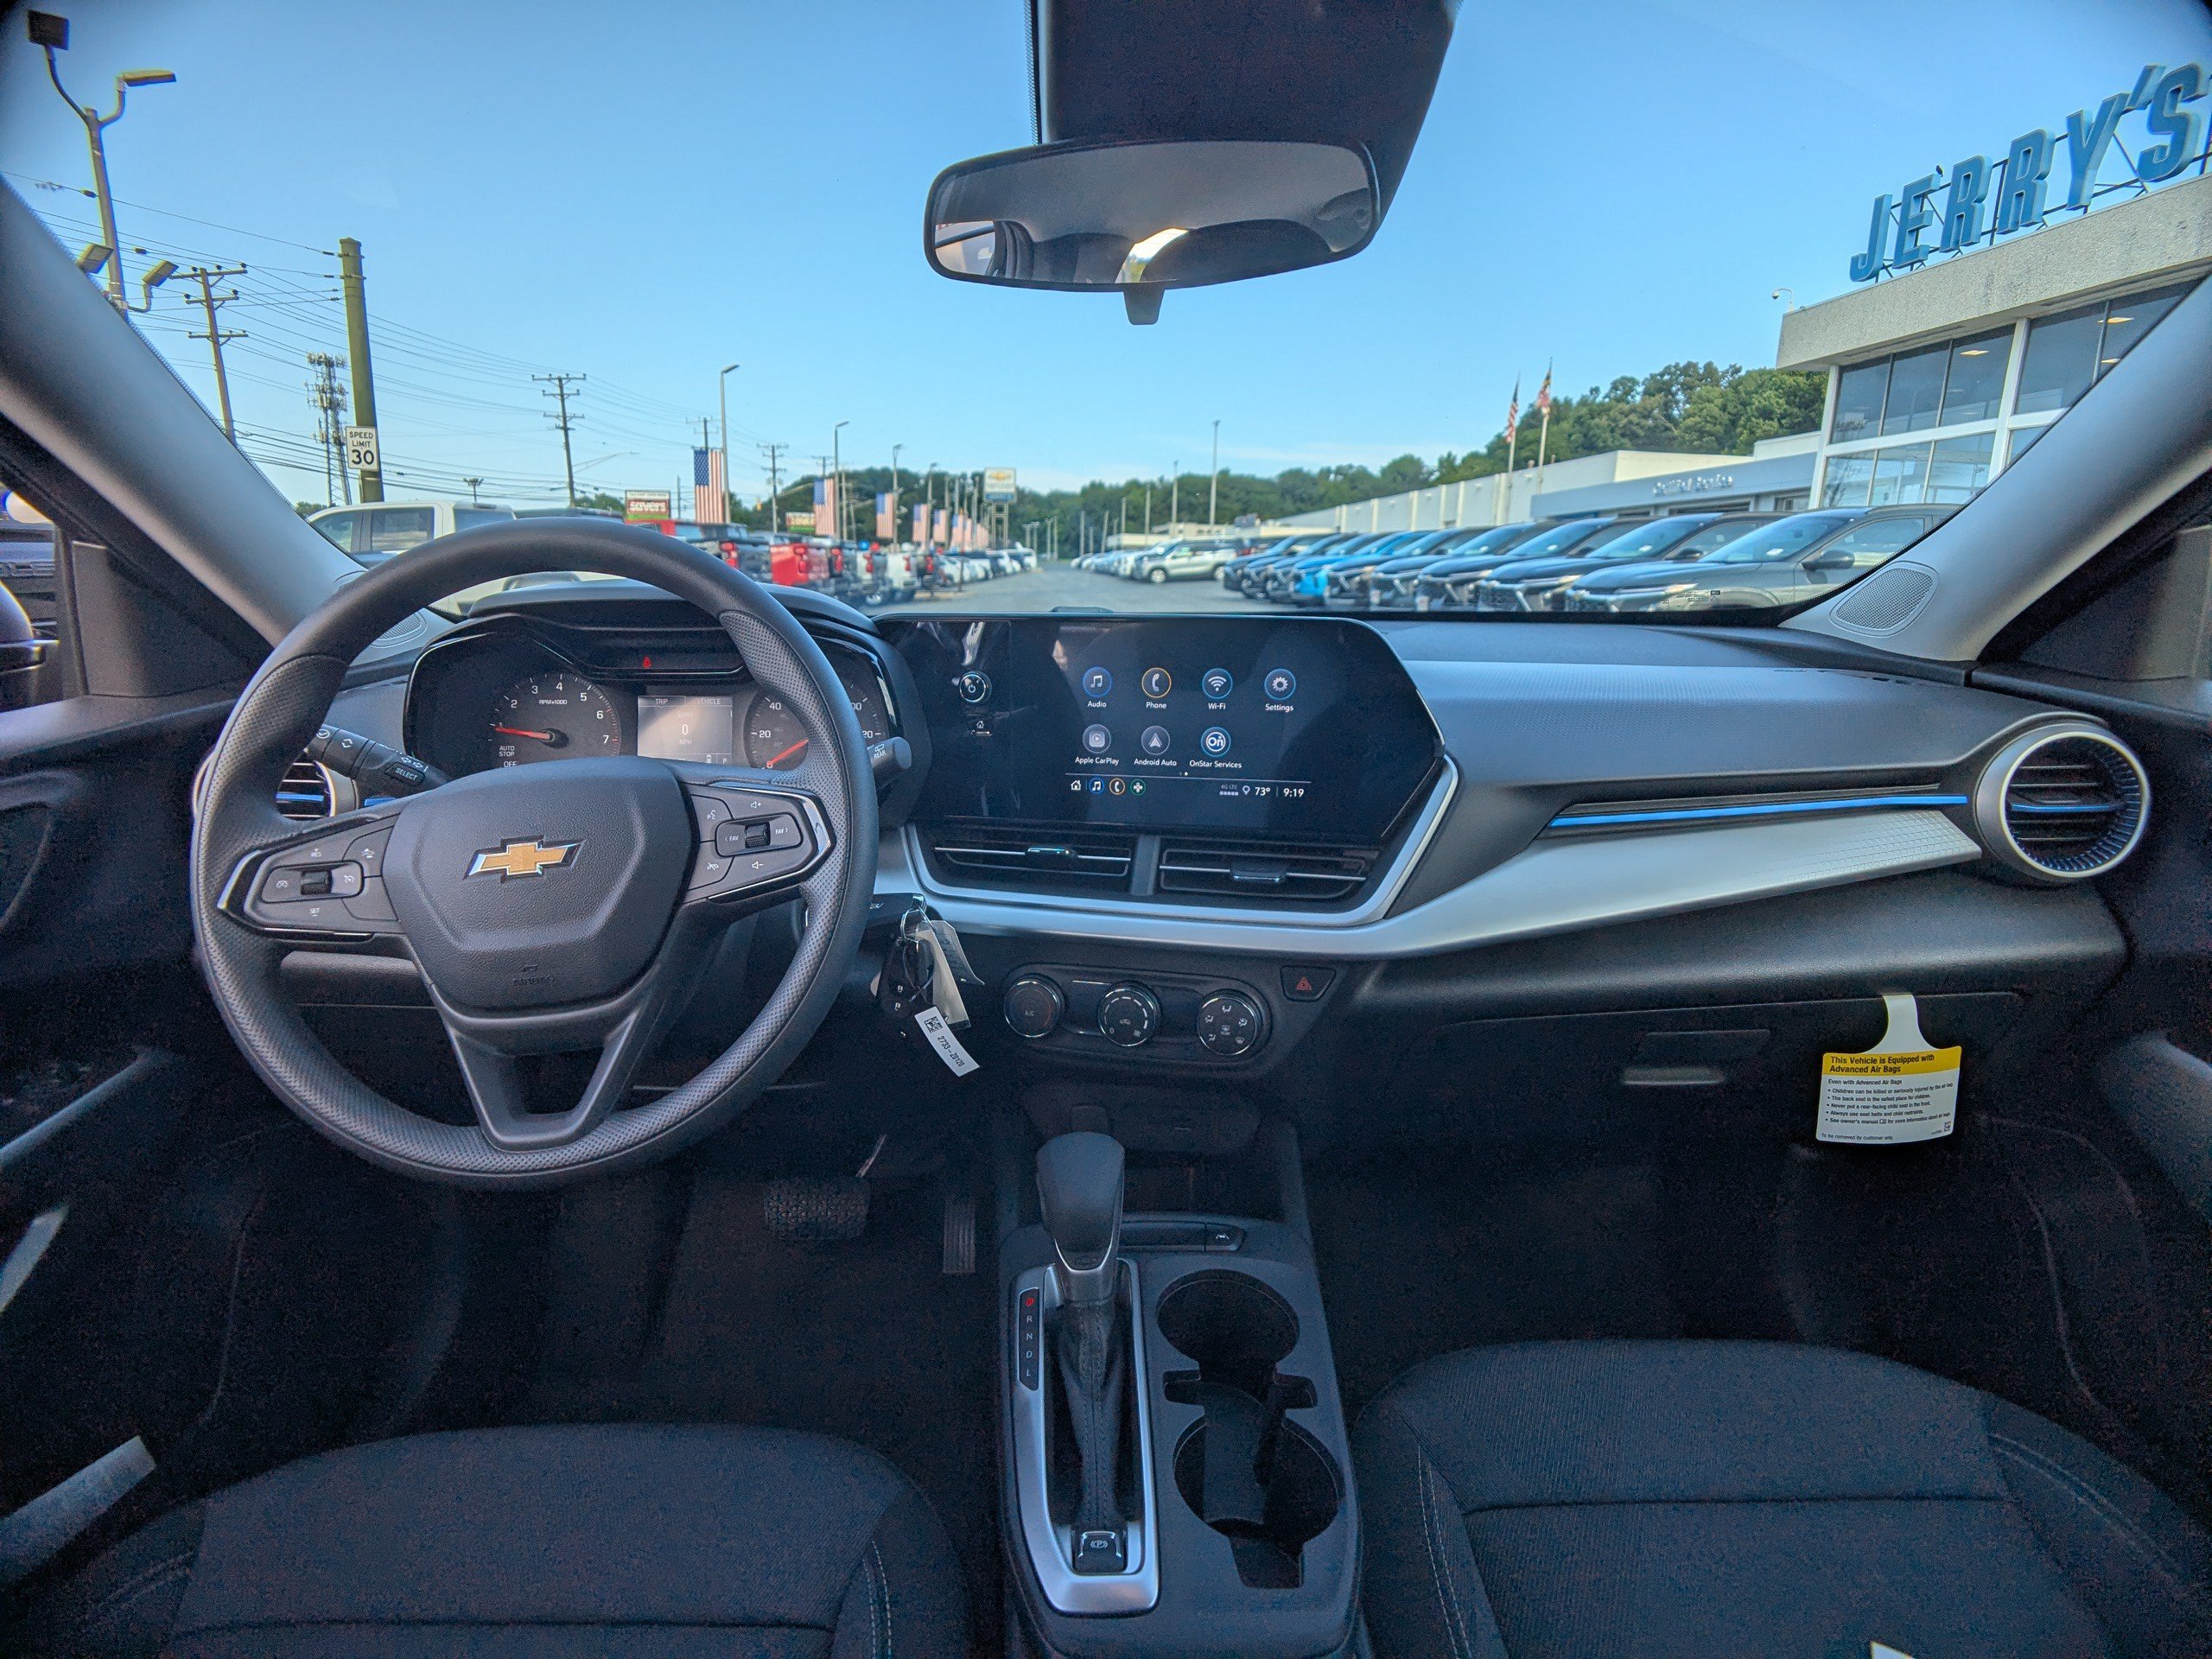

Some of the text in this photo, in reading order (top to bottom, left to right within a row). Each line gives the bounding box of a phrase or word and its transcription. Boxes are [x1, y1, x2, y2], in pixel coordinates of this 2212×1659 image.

[1849, 63, 2210, 283] JERRY'S
[352, 449, 374, 465] 30
[531, 685, 538, 694] 3
[556, 682, 563, 691] 4
[580, 692, 588, 702] 5
[511, 699, 518, 709] 2
[1265, 703, 1294, 713] Settings
[596, 710, 604, 720] 6
[682, 724, 689, 735] 0
[602, 735, 610, 744] 7
[1208, 735, 1224, 747] On
[874, 749, 886, 760] REAR
[1095, 757, 1120, 766] CarPlay
[395, 767, 418, 780] SELECT
[1283, 787, 1305, 797] 9:19
[1888, 1056, 1919, 1065] Equipped
[1884, 1065, 1901, 1074] Bags
[1025, 1298, 1035, 1307] P
[1026, 1332, 1033, 1341] N
